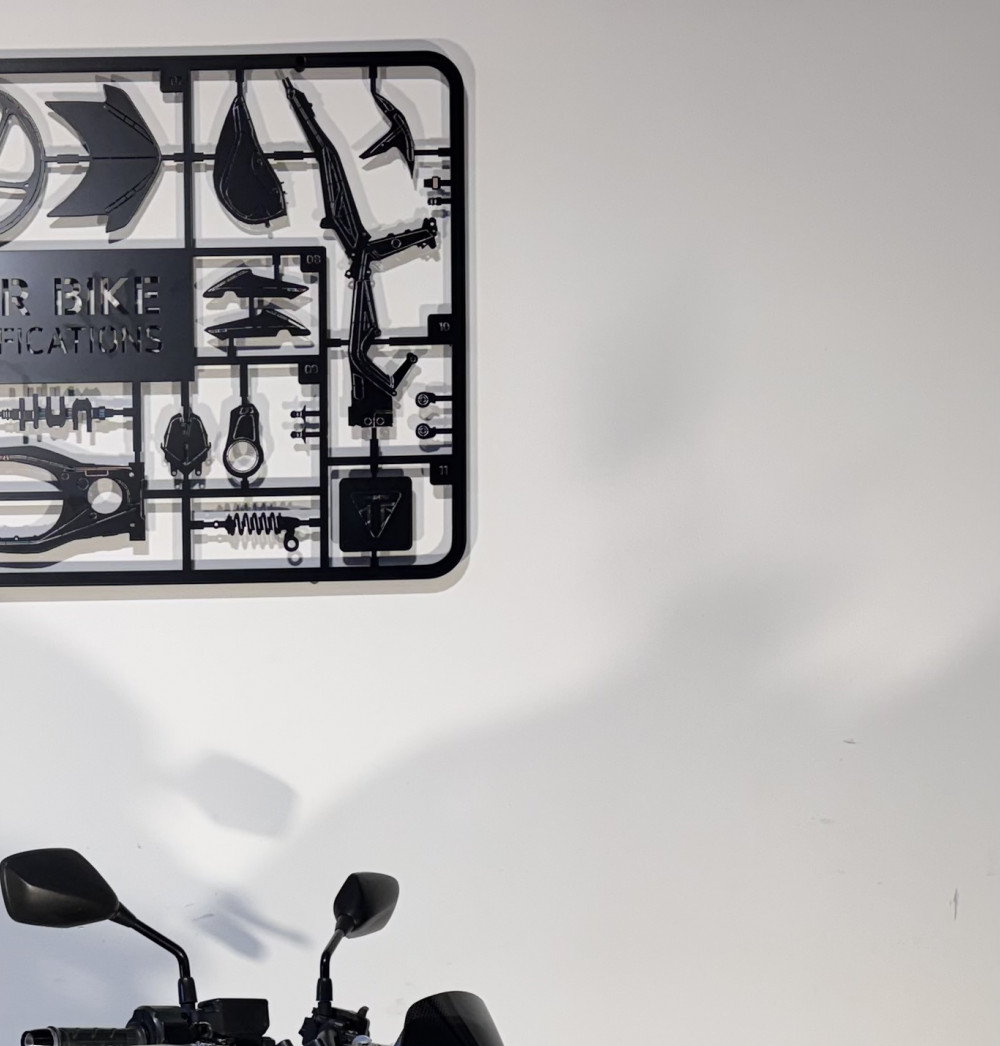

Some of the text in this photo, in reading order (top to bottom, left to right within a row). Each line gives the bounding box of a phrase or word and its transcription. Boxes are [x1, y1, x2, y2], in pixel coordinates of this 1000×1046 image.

[54, 276, 160, 316] BIKE
[438, 321, 451, 332] 10
[438, 465, 449, 476] 11
